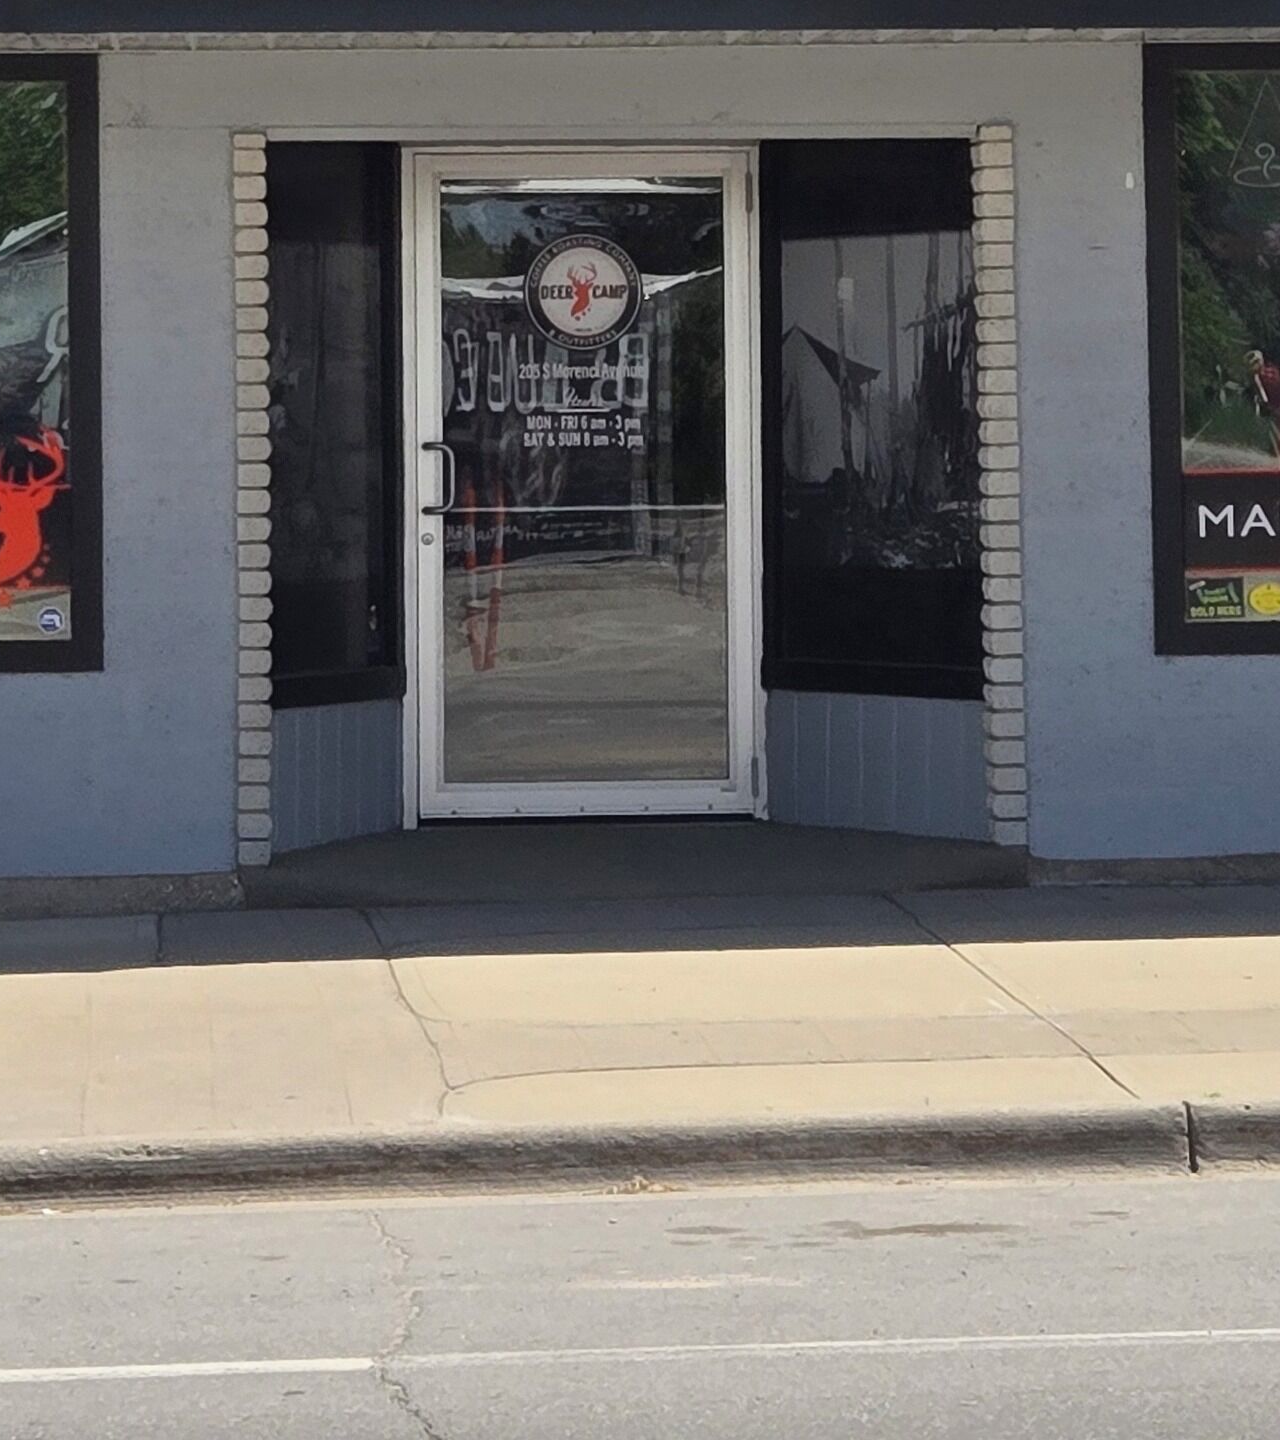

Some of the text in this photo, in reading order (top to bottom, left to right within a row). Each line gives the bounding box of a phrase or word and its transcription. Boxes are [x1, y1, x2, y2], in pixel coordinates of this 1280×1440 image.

[541, 285, 627, 300] DEER CAMP
[519, 363, 540, 379] 205
[543, 363, 550, 380] S
[527, 415, 551, 429] MON
[561, 415, 578, 429] FRI
[581, 415, 588, 429] 6
[616, 415, 622, 429] 3
[624, 418, 640, 432] pm
[524, 432, 544, 446] SAT
[547, 432, 555, 446] &
[559, 432, 580, 446] SUN
[618, 432, 624, 446] 3
[627, 435, 643, 449] pm
[1217, 606, 1242, 616] HERE
